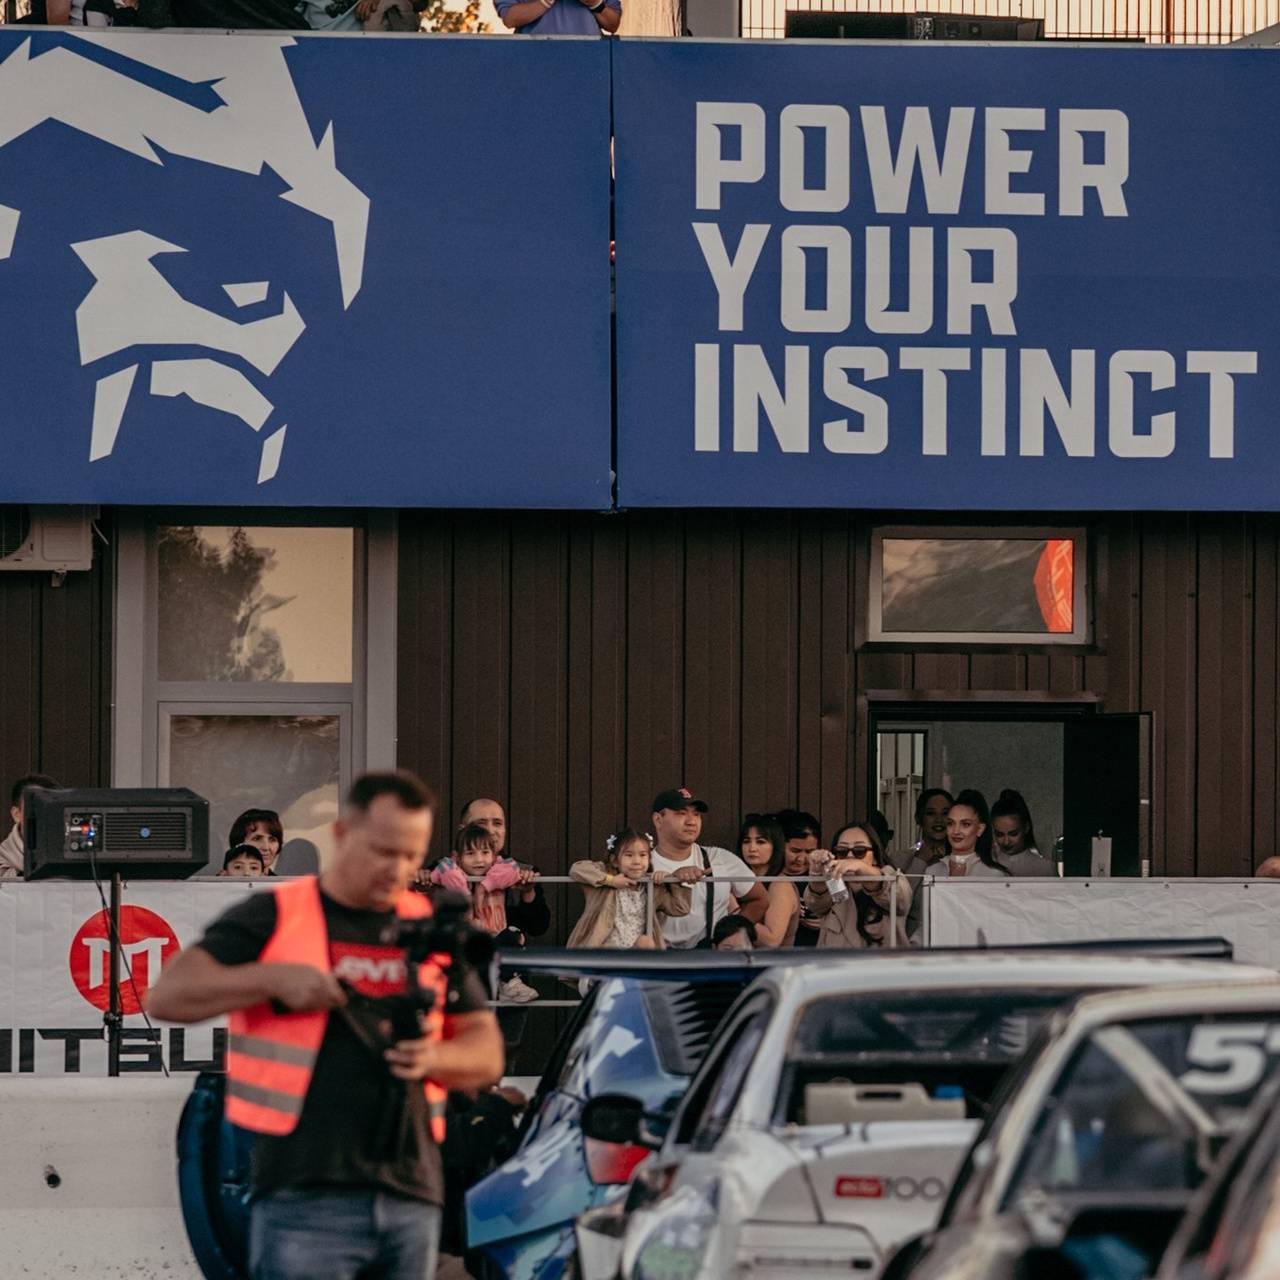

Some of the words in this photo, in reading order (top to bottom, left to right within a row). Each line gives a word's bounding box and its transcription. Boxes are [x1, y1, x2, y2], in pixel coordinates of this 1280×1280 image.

[695, 101, 1130, 217] POWER
[692, 222, 1018, 336] YOUR
[694, 343, 1258, 459] INSTINCT
[0, 1027, 229, 1074] ITSU
